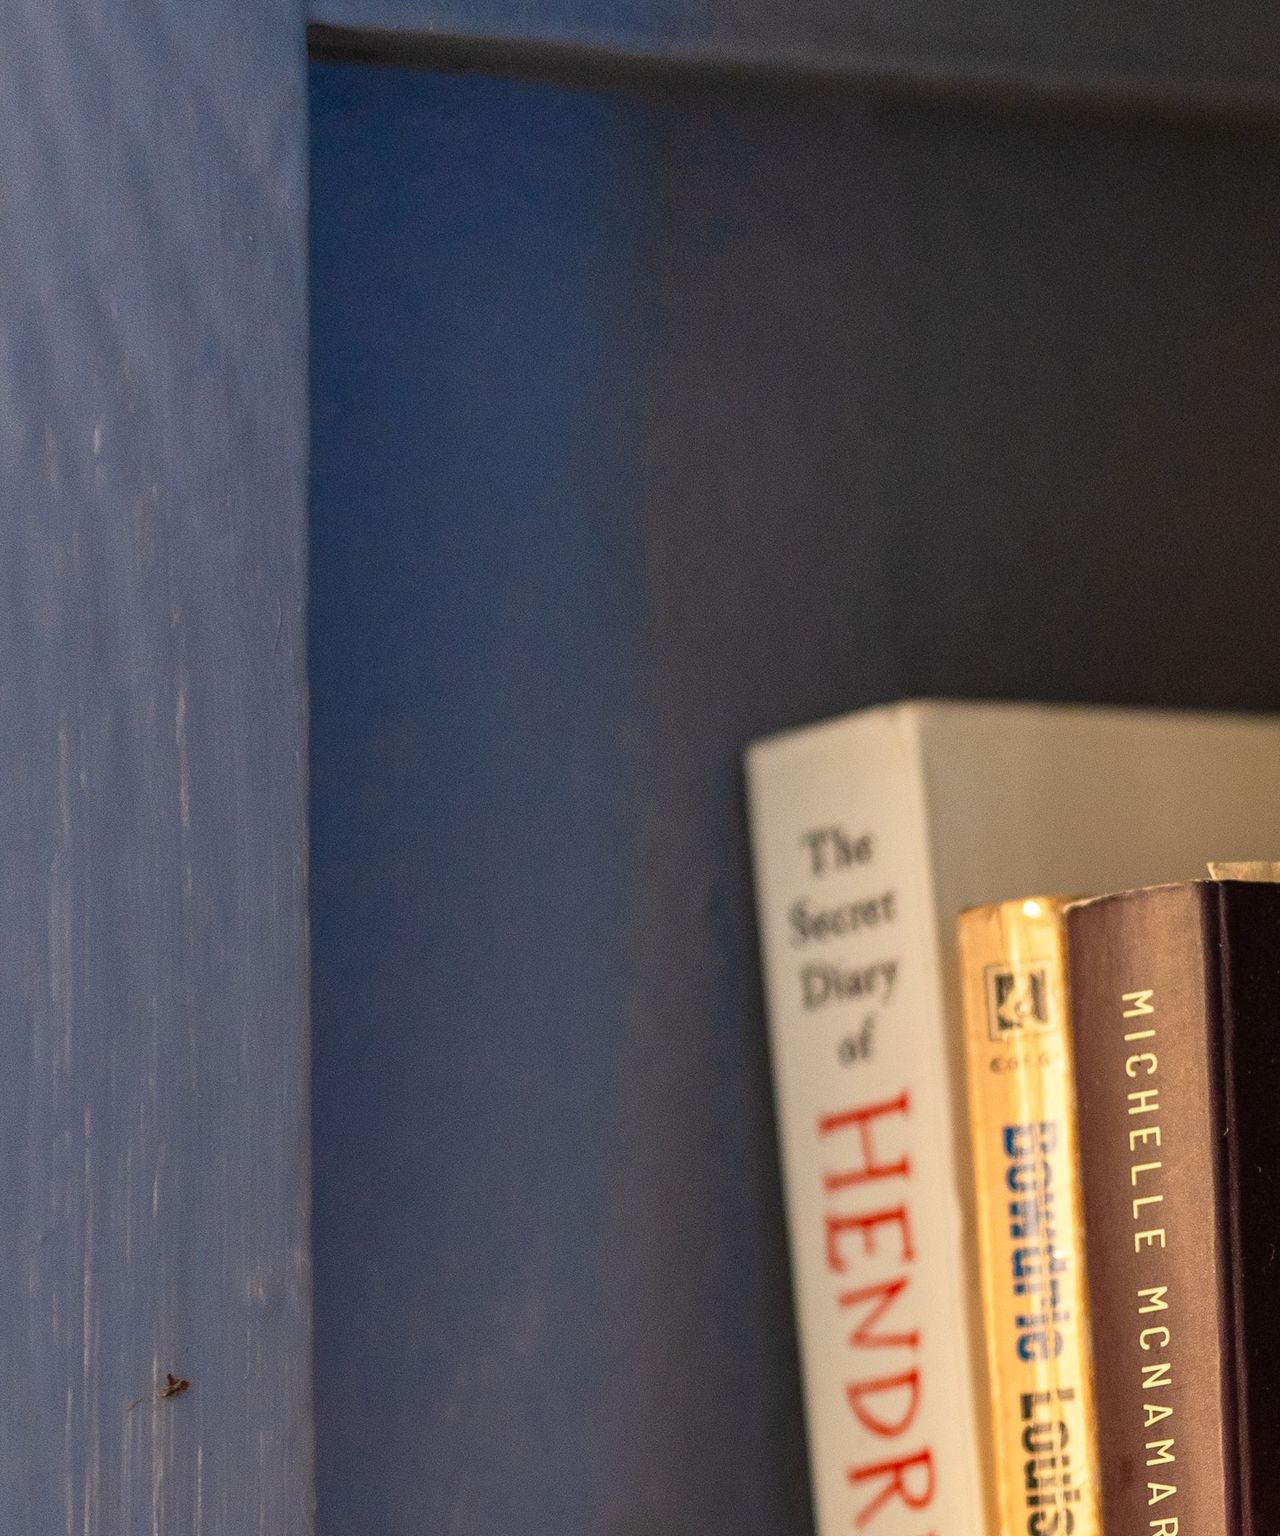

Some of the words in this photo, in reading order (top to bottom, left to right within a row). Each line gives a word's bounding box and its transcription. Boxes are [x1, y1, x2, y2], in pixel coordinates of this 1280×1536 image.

[806, 825, 875, 879] The
[789, 890, 896, 951] Secret
[800, 954, 900, 1014] Diary
[837, 1012, 877, 1069] of
[1121, 988, 1166, 1254] MICHELLE
[1002, 1120, 1071, 1364] Bowdrie
